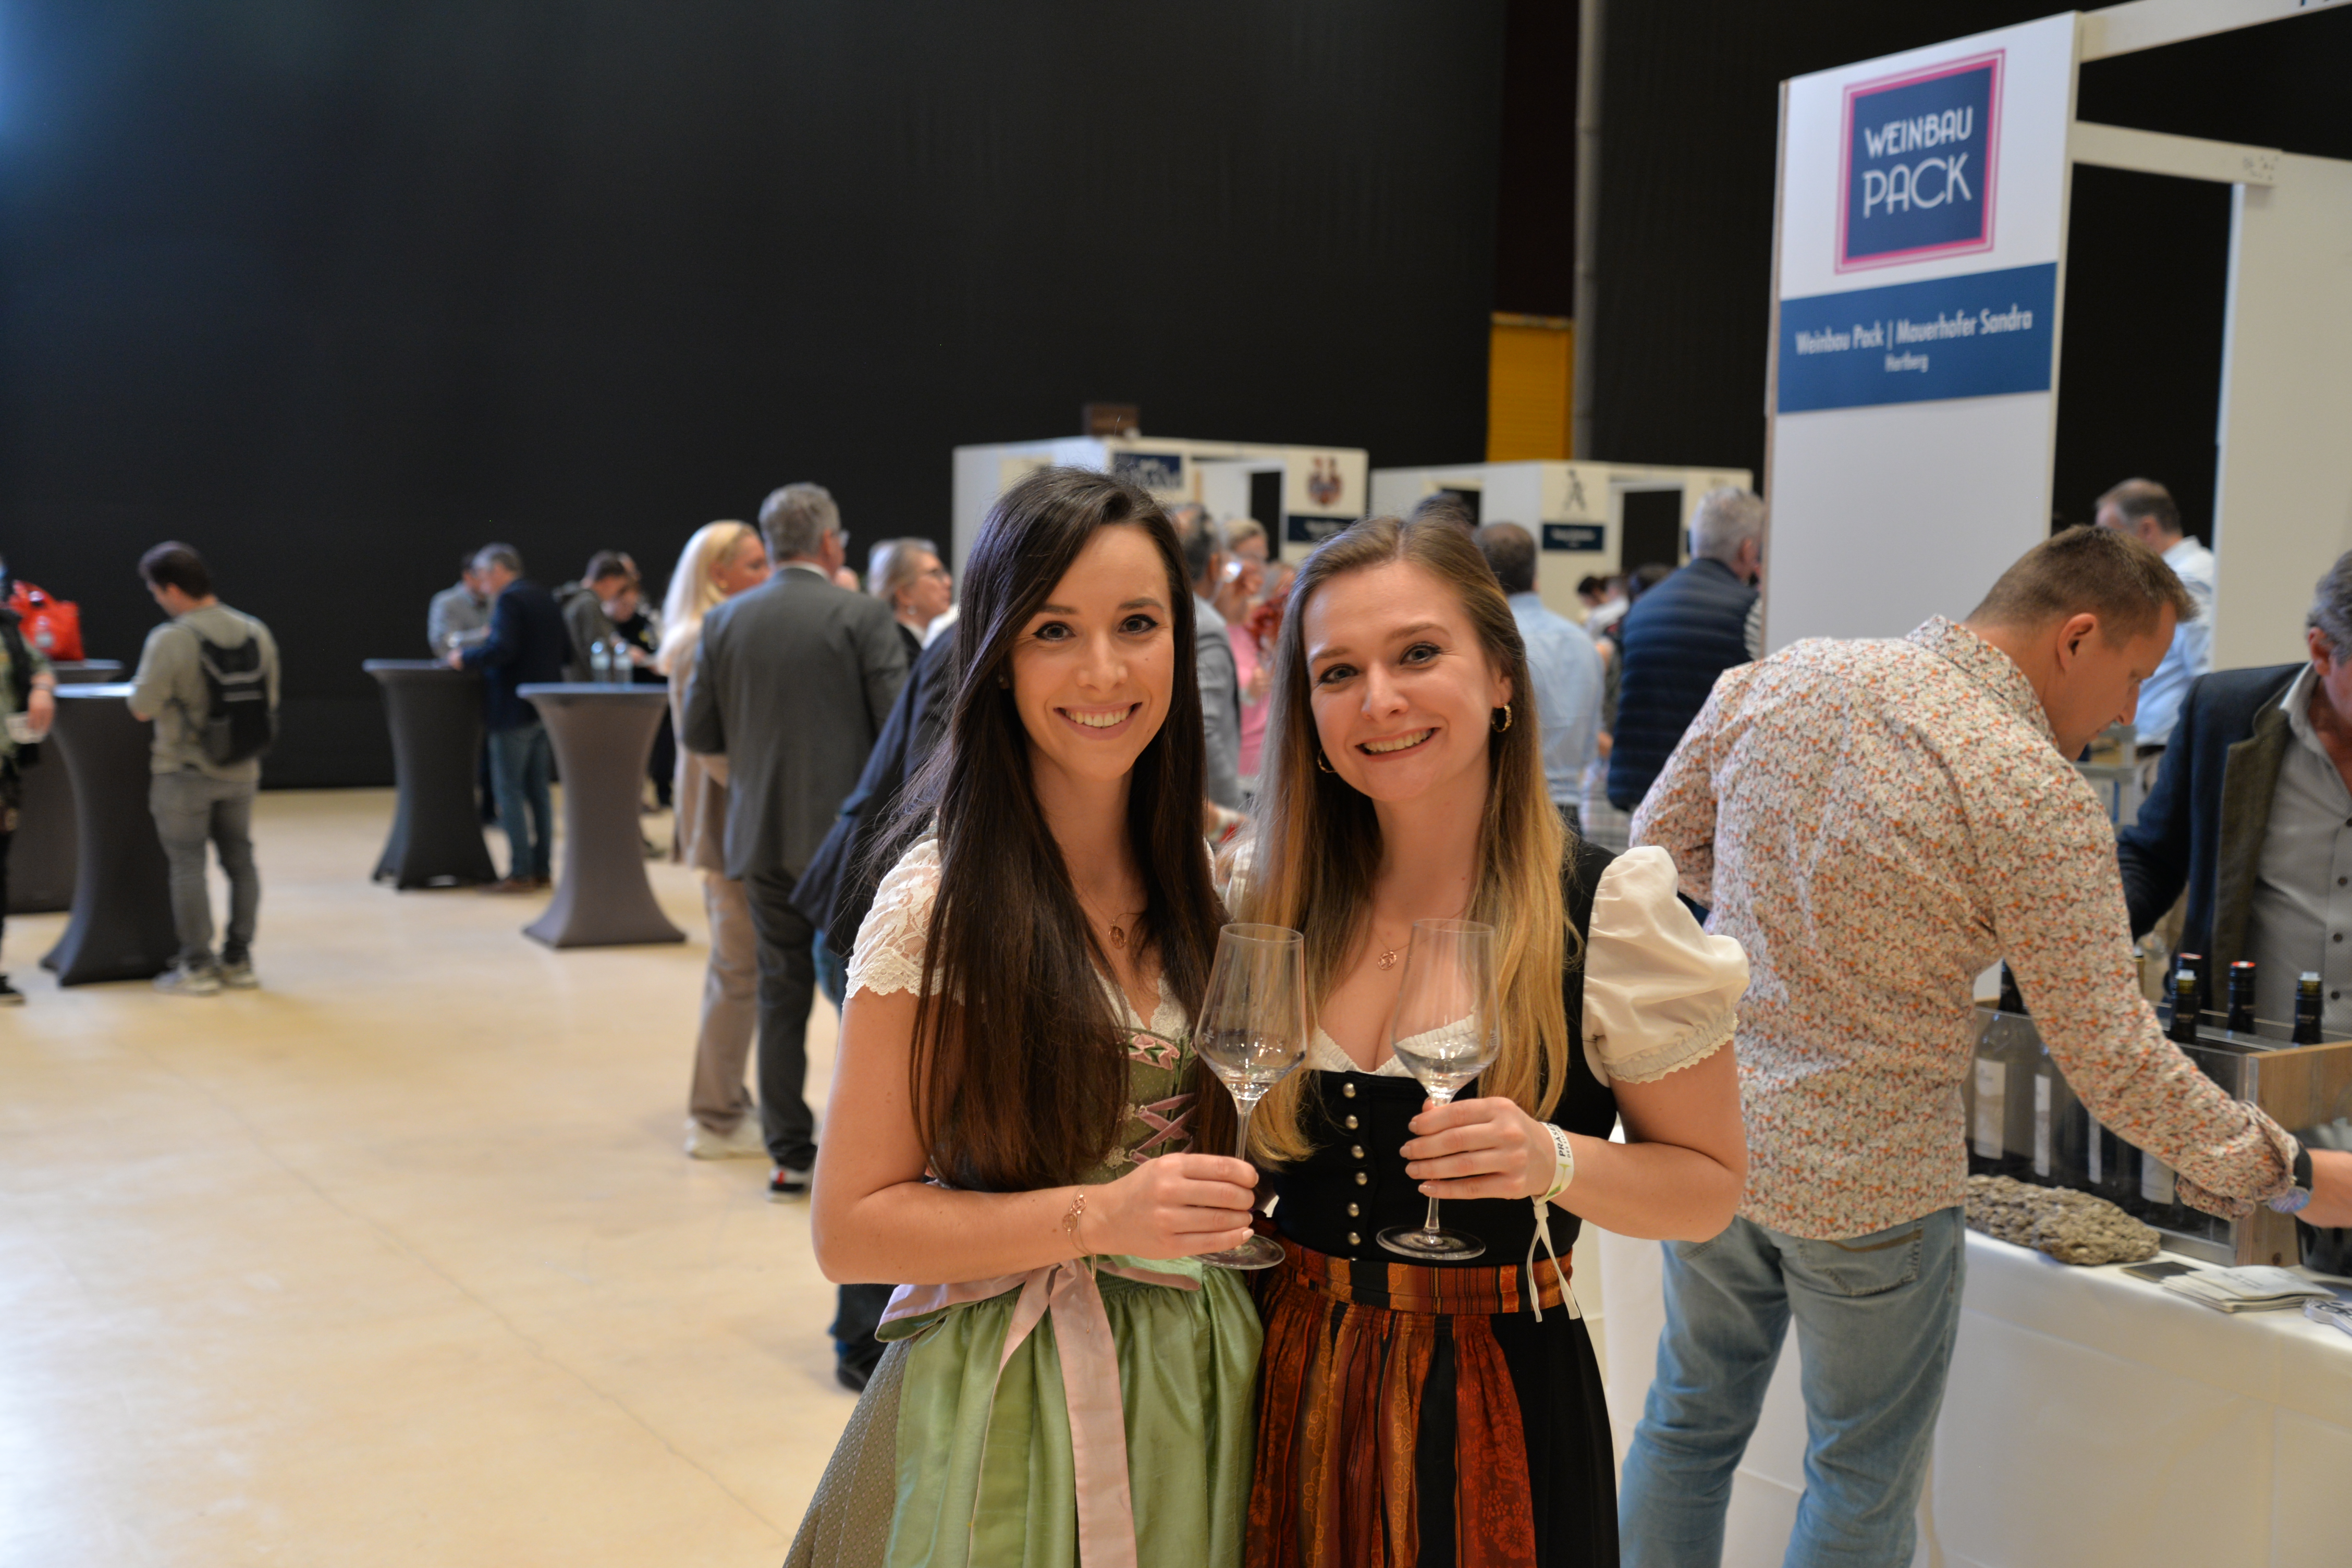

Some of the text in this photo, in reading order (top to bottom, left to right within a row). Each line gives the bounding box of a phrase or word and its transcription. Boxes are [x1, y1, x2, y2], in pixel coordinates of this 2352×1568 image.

[1864, 106, 1973, 158] WEINBAU
[1863, 152, 1971, 219] PACK
[1796, 326, 1851, 355] Weinbau
[1853, 320, 1884, 349] Pack
[1896, 310, 1977, 345] Mauerhofer
[1980, 303, 2032, 335] Sandra
